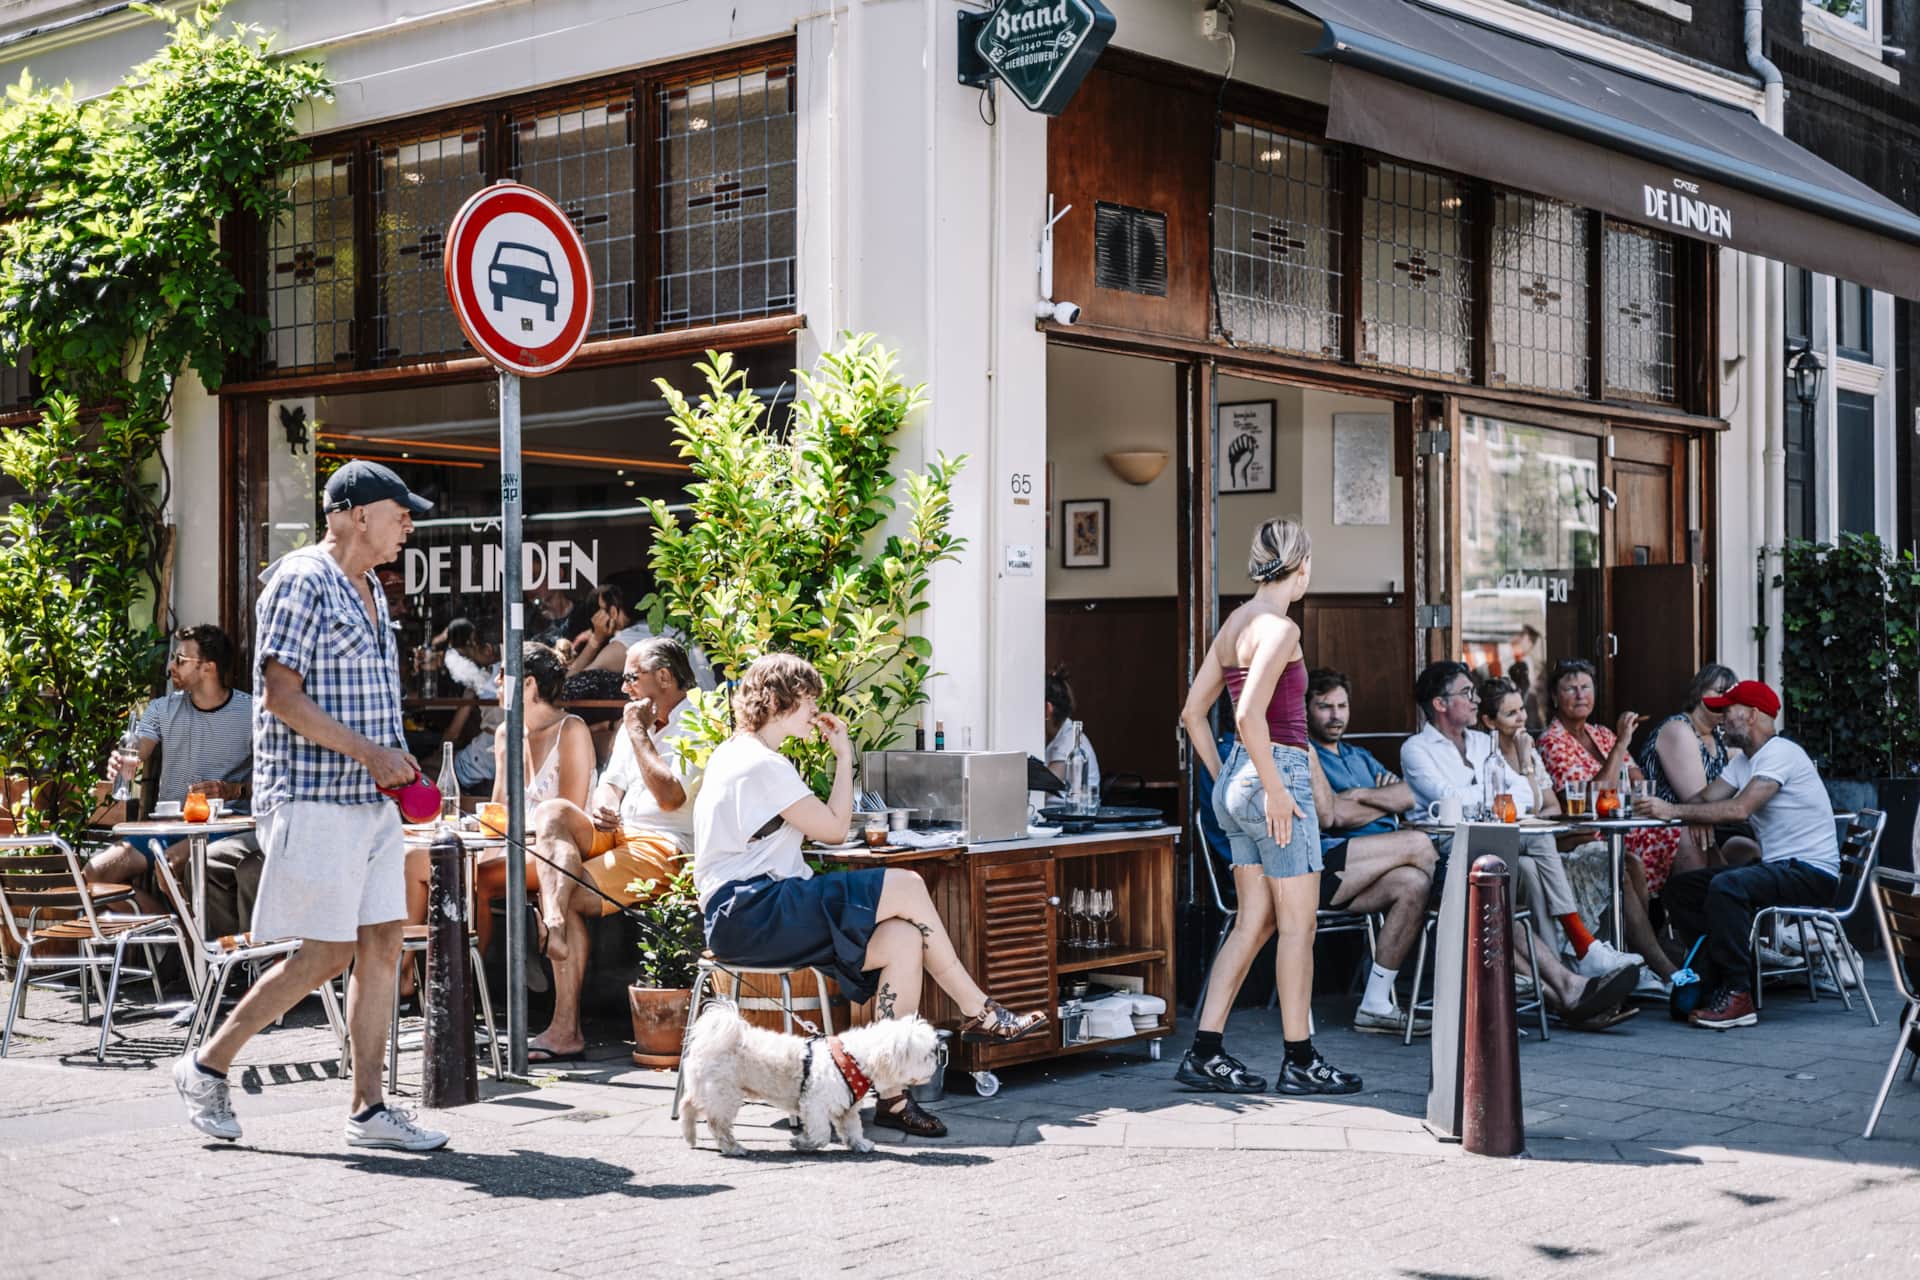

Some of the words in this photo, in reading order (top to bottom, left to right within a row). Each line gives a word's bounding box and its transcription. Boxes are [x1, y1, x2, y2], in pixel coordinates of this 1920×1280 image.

[996, 0, 1068, 40] Brand
[1021, 40, 1041, 52] 1340
[1643, 184, 1669, 222] DE
[1670, 192, 1732, 240] LINDEN
[1011, 473, 1032, 494] 65
[404, 546, 451, 595] DE
